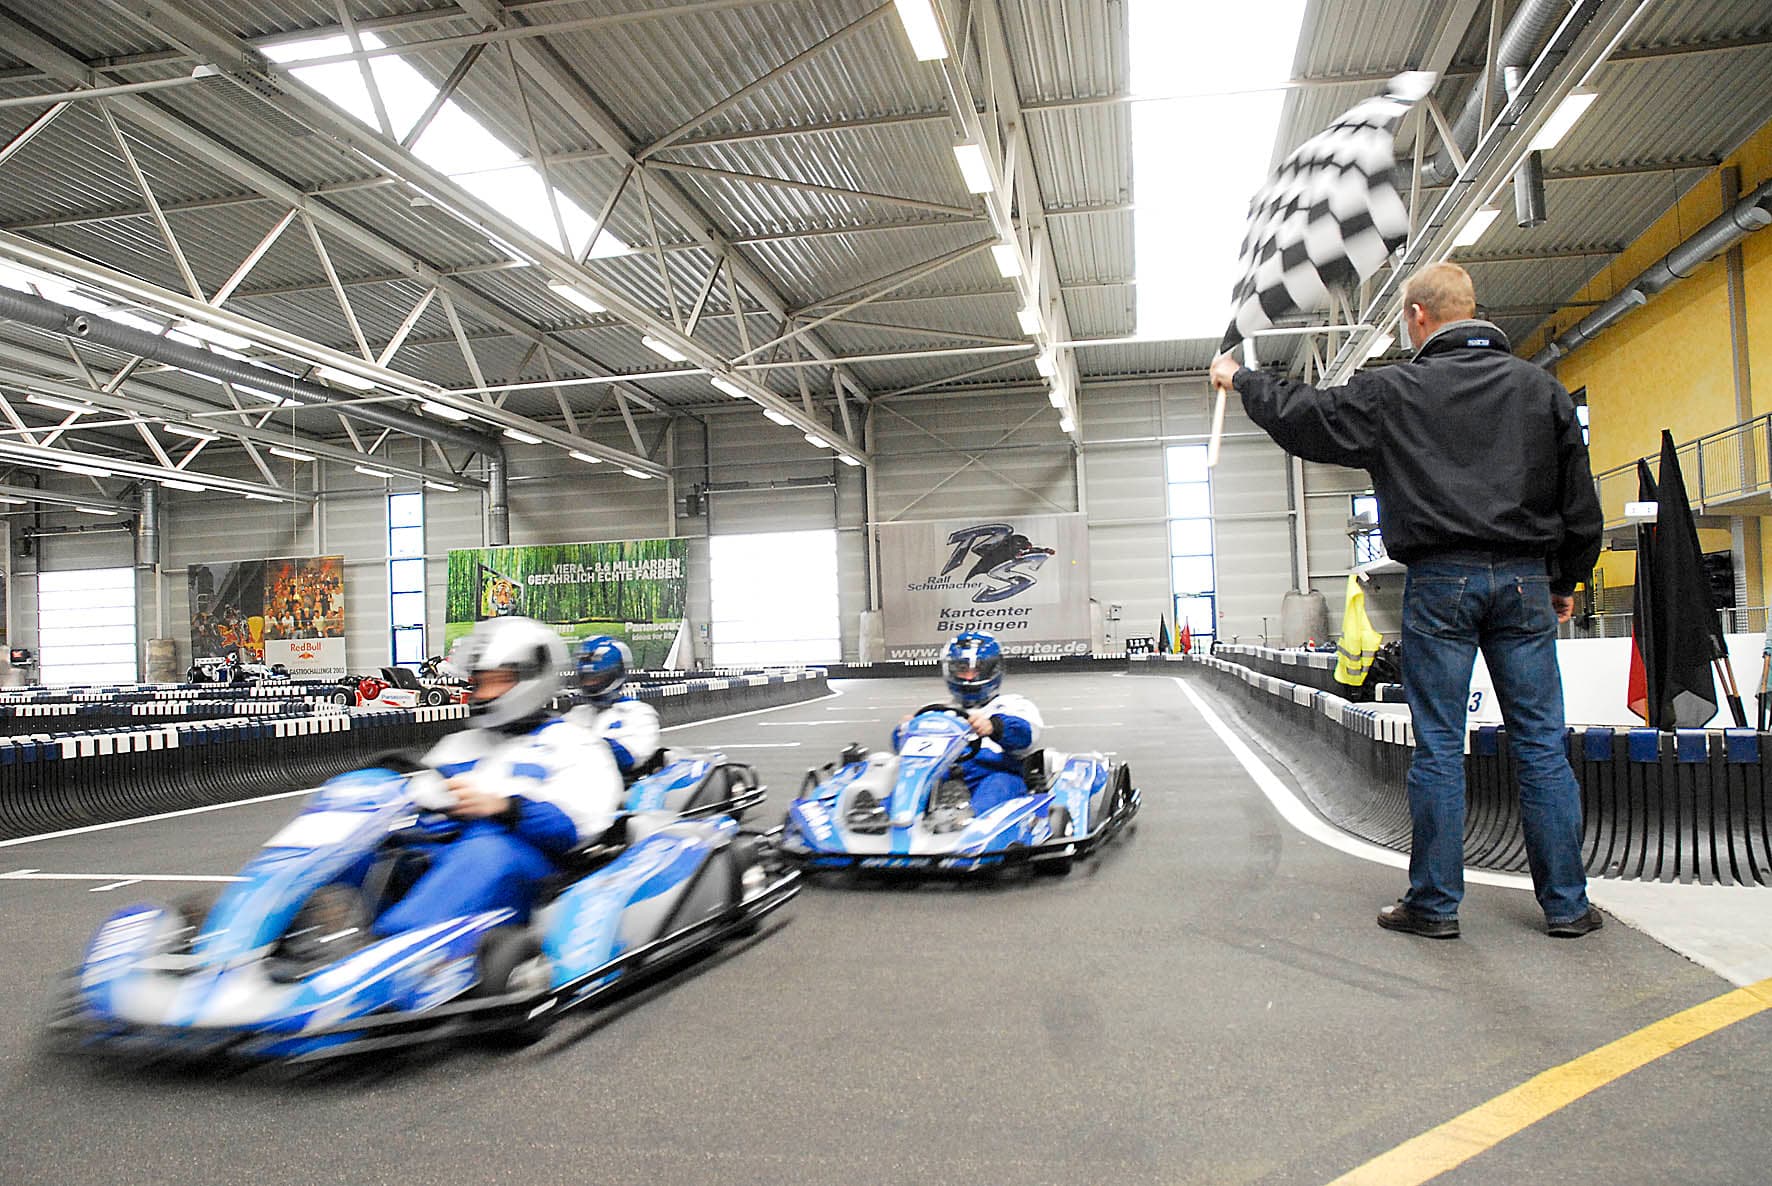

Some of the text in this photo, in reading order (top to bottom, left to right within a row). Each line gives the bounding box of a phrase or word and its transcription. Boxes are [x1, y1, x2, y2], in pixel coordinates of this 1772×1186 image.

[553, 563, 585, 575] VIERA
[595, 562, 610, 573] 8.6
[613, 558, 681, 573] MILLIARDEN
[597, 571, 634, 583] ECHTE
[927, 575, 951, 585] Ralf
[907, 581, 983, 592] Schumacher
[939, 606, 1032, 619] Kartcenter
[936, 619, 1028, 632] Bispingen
[1468, 691, 1482, 712] 3
